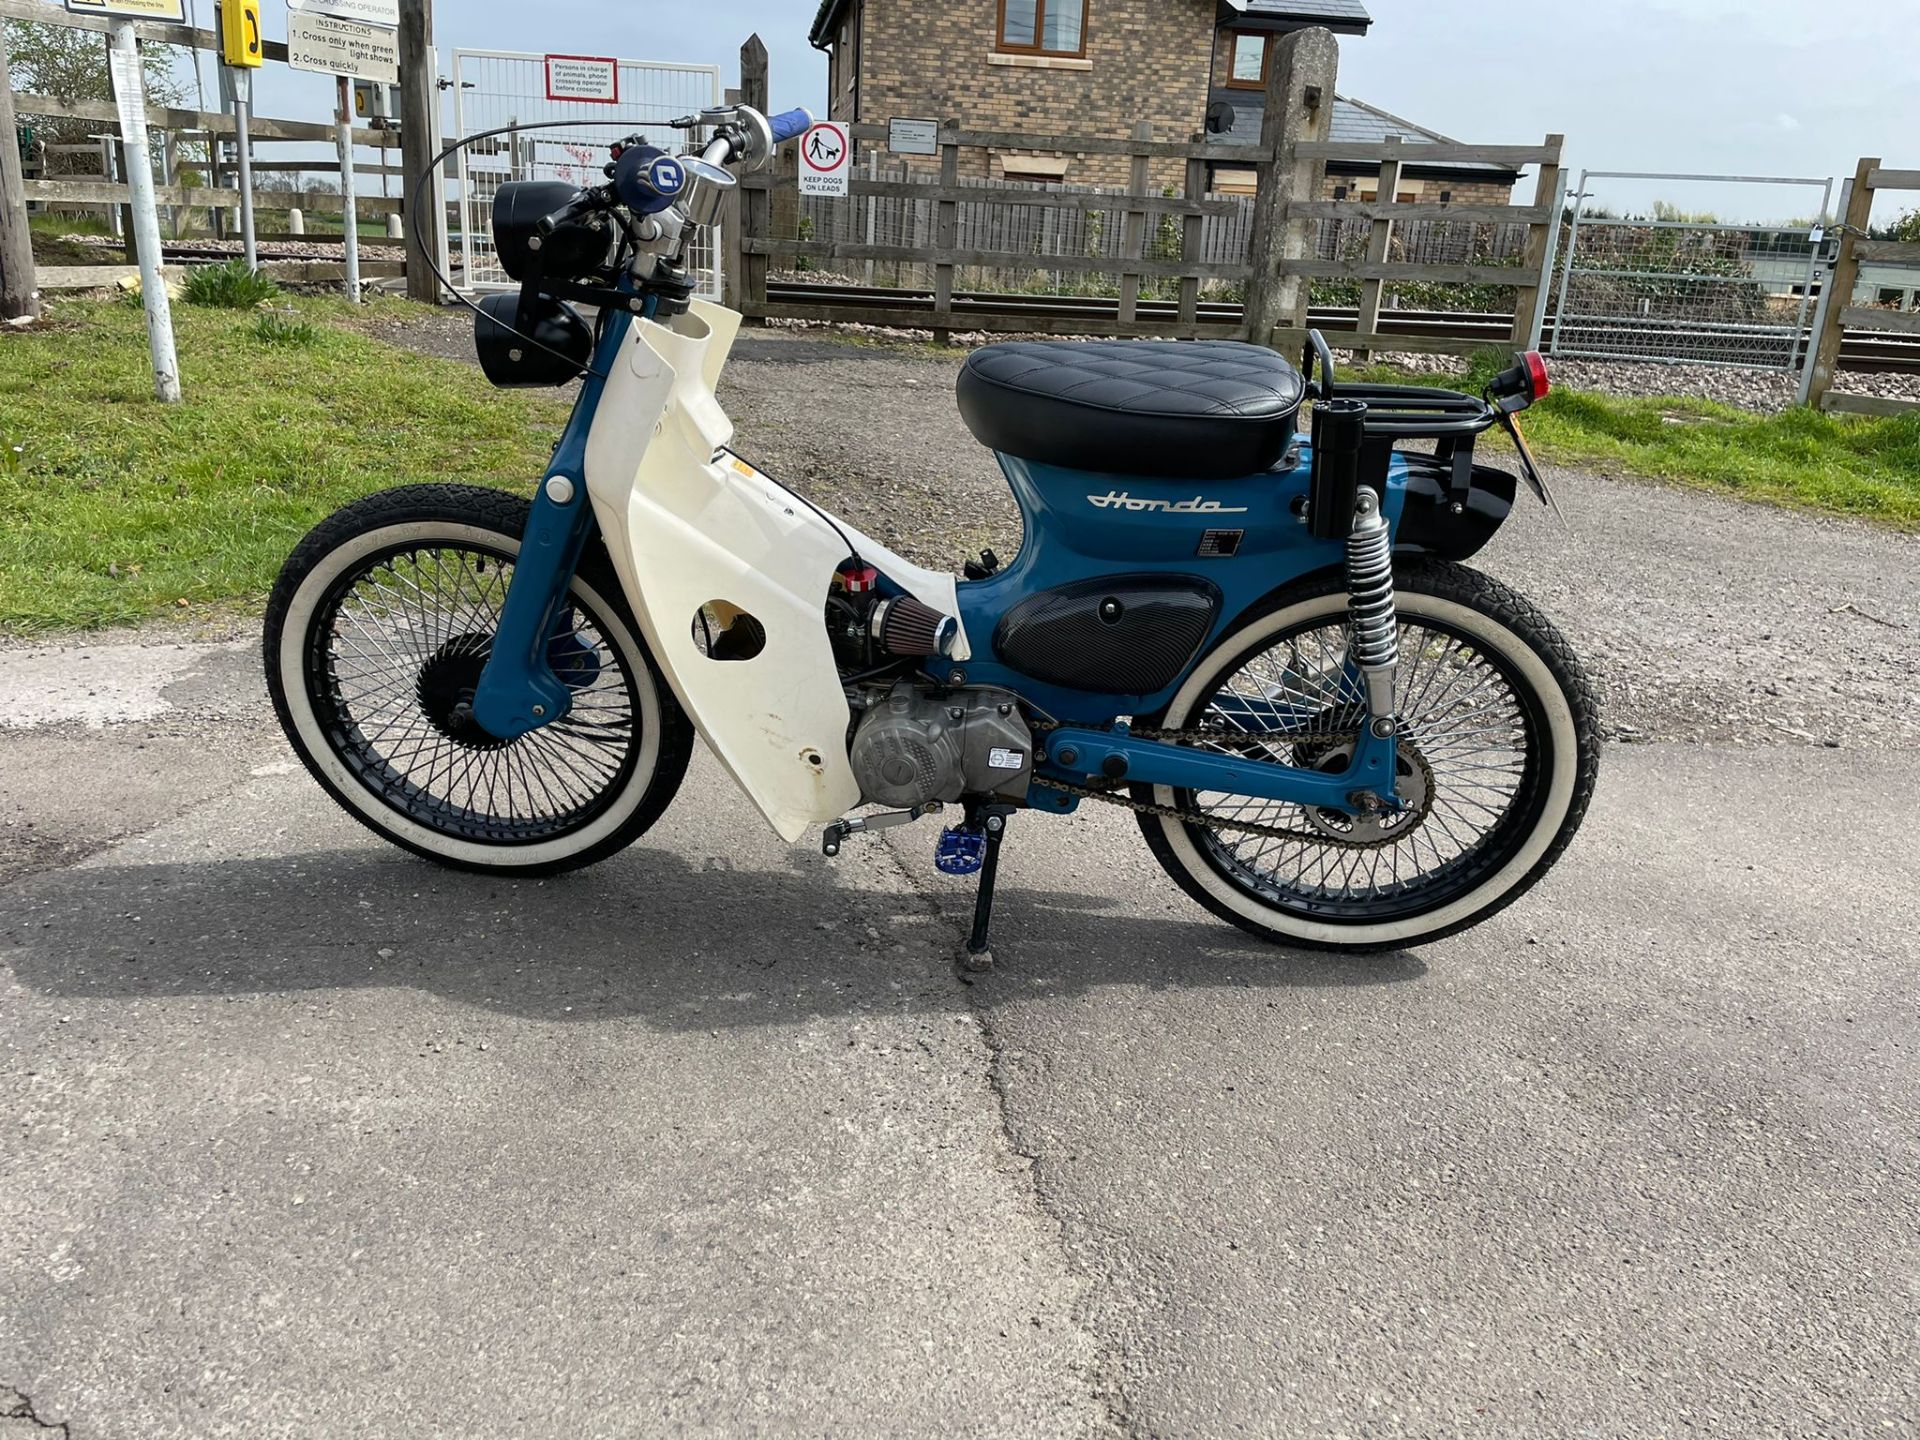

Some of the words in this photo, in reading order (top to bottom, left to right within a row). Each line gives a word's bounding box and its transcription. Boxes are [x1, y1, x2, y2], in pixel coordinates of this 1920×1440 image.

[357, 3, 395, 15] OPERATOR
[316, 19, 371, 35] INSTRUCTIONS
[302, 31, 326, 42] Cross
[329, 37, 346, 47] only
[349, 40, 369, 49] when
[371, 45, 393, 54] green
[293, 53, 302, 62] 2.
[303, 54, 327, 66] Cross
[330, 60, 359, 72] quickly
[350, 49, 368, 60] light
[370, 54, 393, 64] shows
[555, 63, 579, 71] Persons
[1087, 491, 1248, 513] Honda
